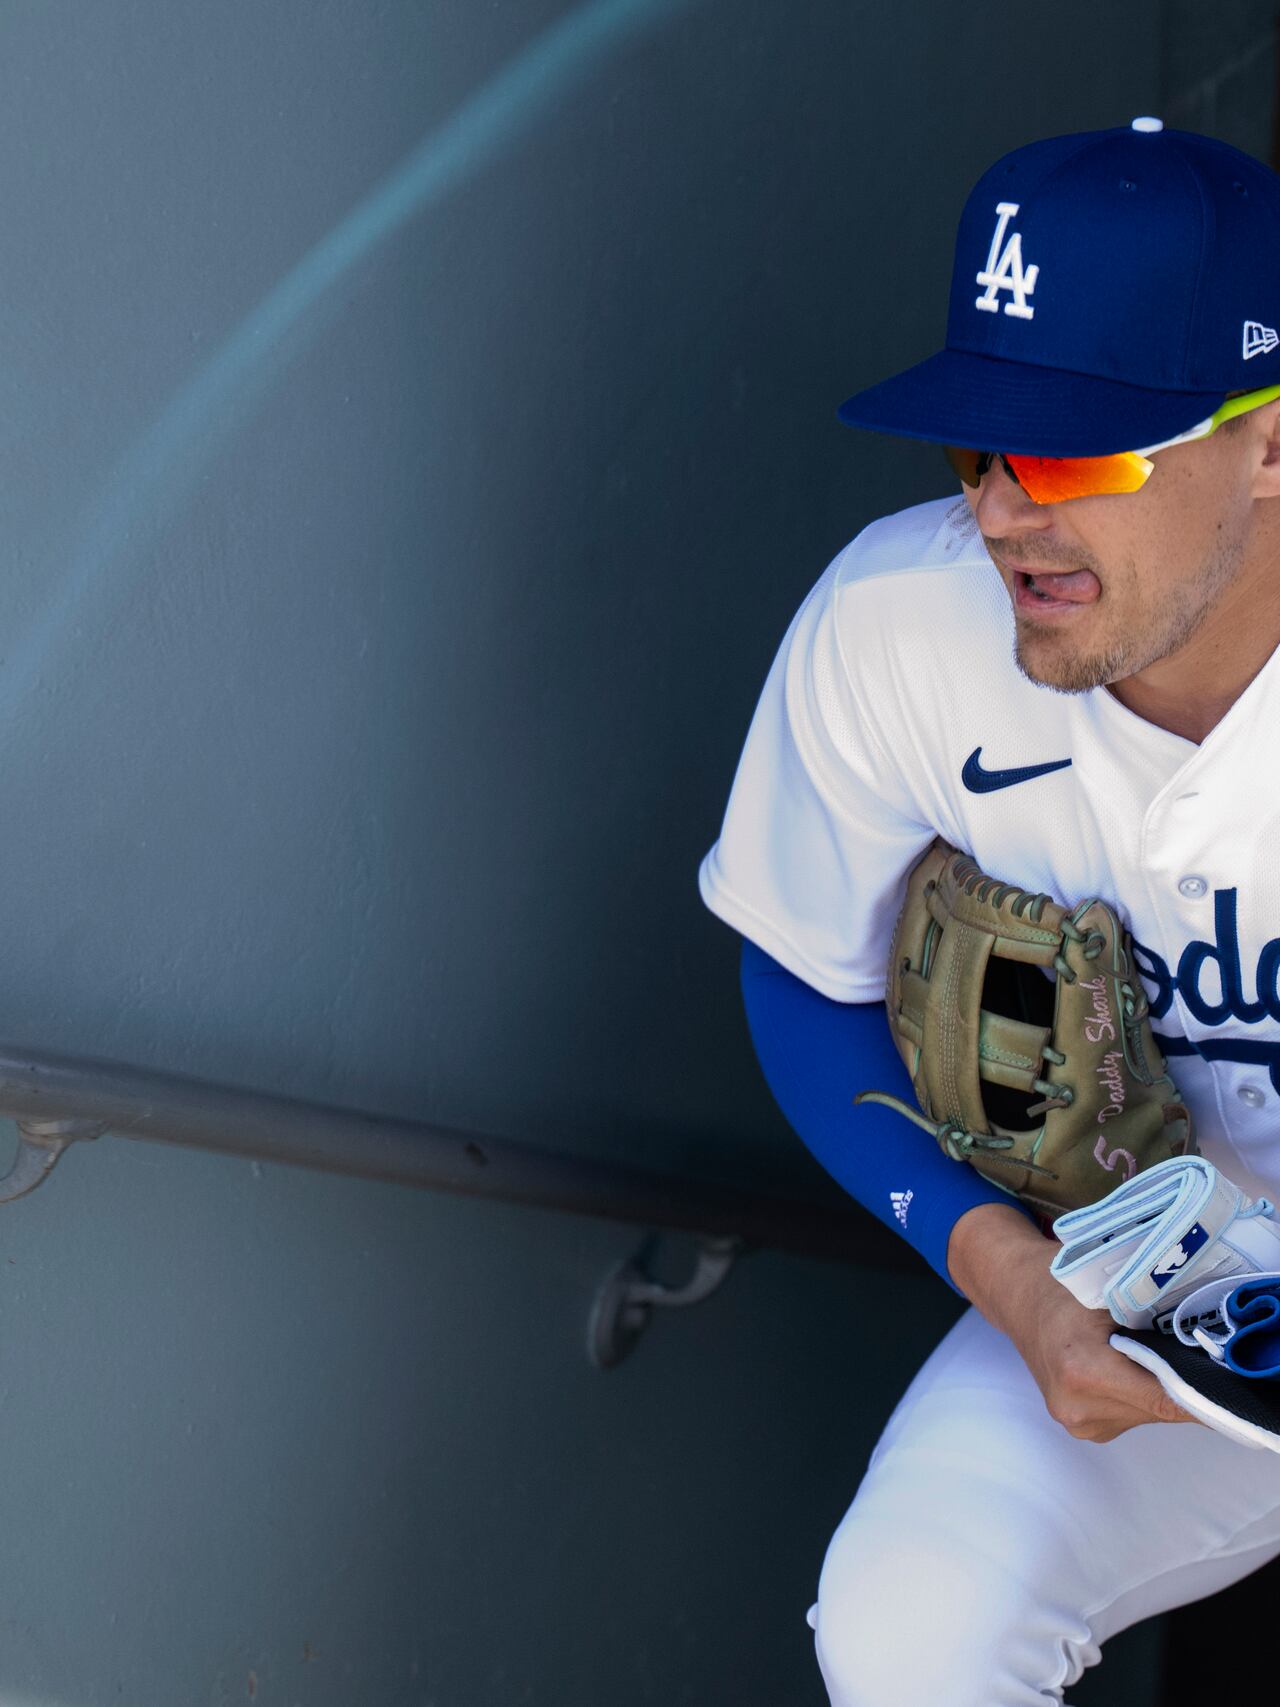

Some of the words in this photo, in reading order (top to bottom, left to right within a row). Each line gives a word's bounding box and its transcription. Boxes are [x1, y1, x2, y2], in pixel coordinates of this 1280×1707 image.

[976, 202, 1039, 320] LA
[1079, 974, 1116, 1043] Shark
[1096, 1050, 1124, 1123] Daddy
